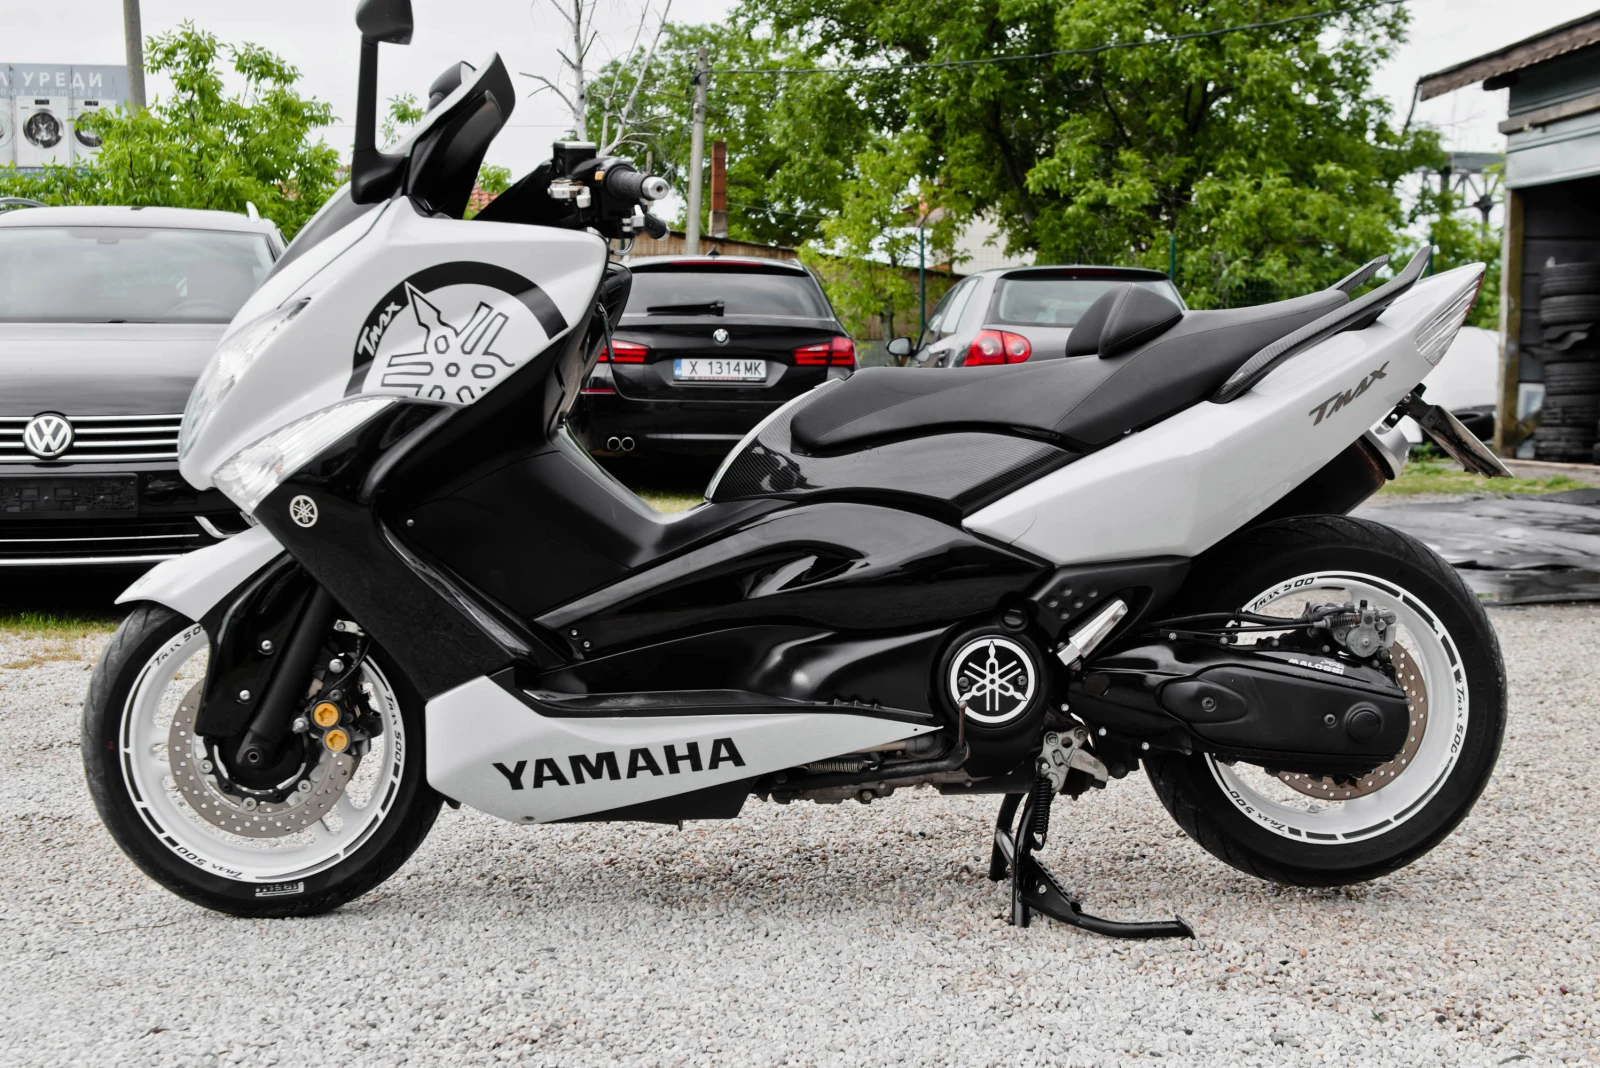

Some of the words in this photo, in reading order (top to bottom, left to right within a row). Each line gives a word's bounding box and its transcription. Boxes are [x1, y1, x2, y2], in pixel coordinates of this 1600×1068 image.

[22, 71, 103, 90] УРЕДИ
[689, 361, 698, 375] X
[708, 361, 741, 375] 1314
[26, 415, 72, 457] VW
[1283, 577, 1314, 591] 500
[183, 625, 202, 642] 50
[394, 730, 402, 763] 500
[491, 737, 747, 791] YAMAHA
[1230, 791, 1255, 813] 500
[177, 847, 207, 866] 500
